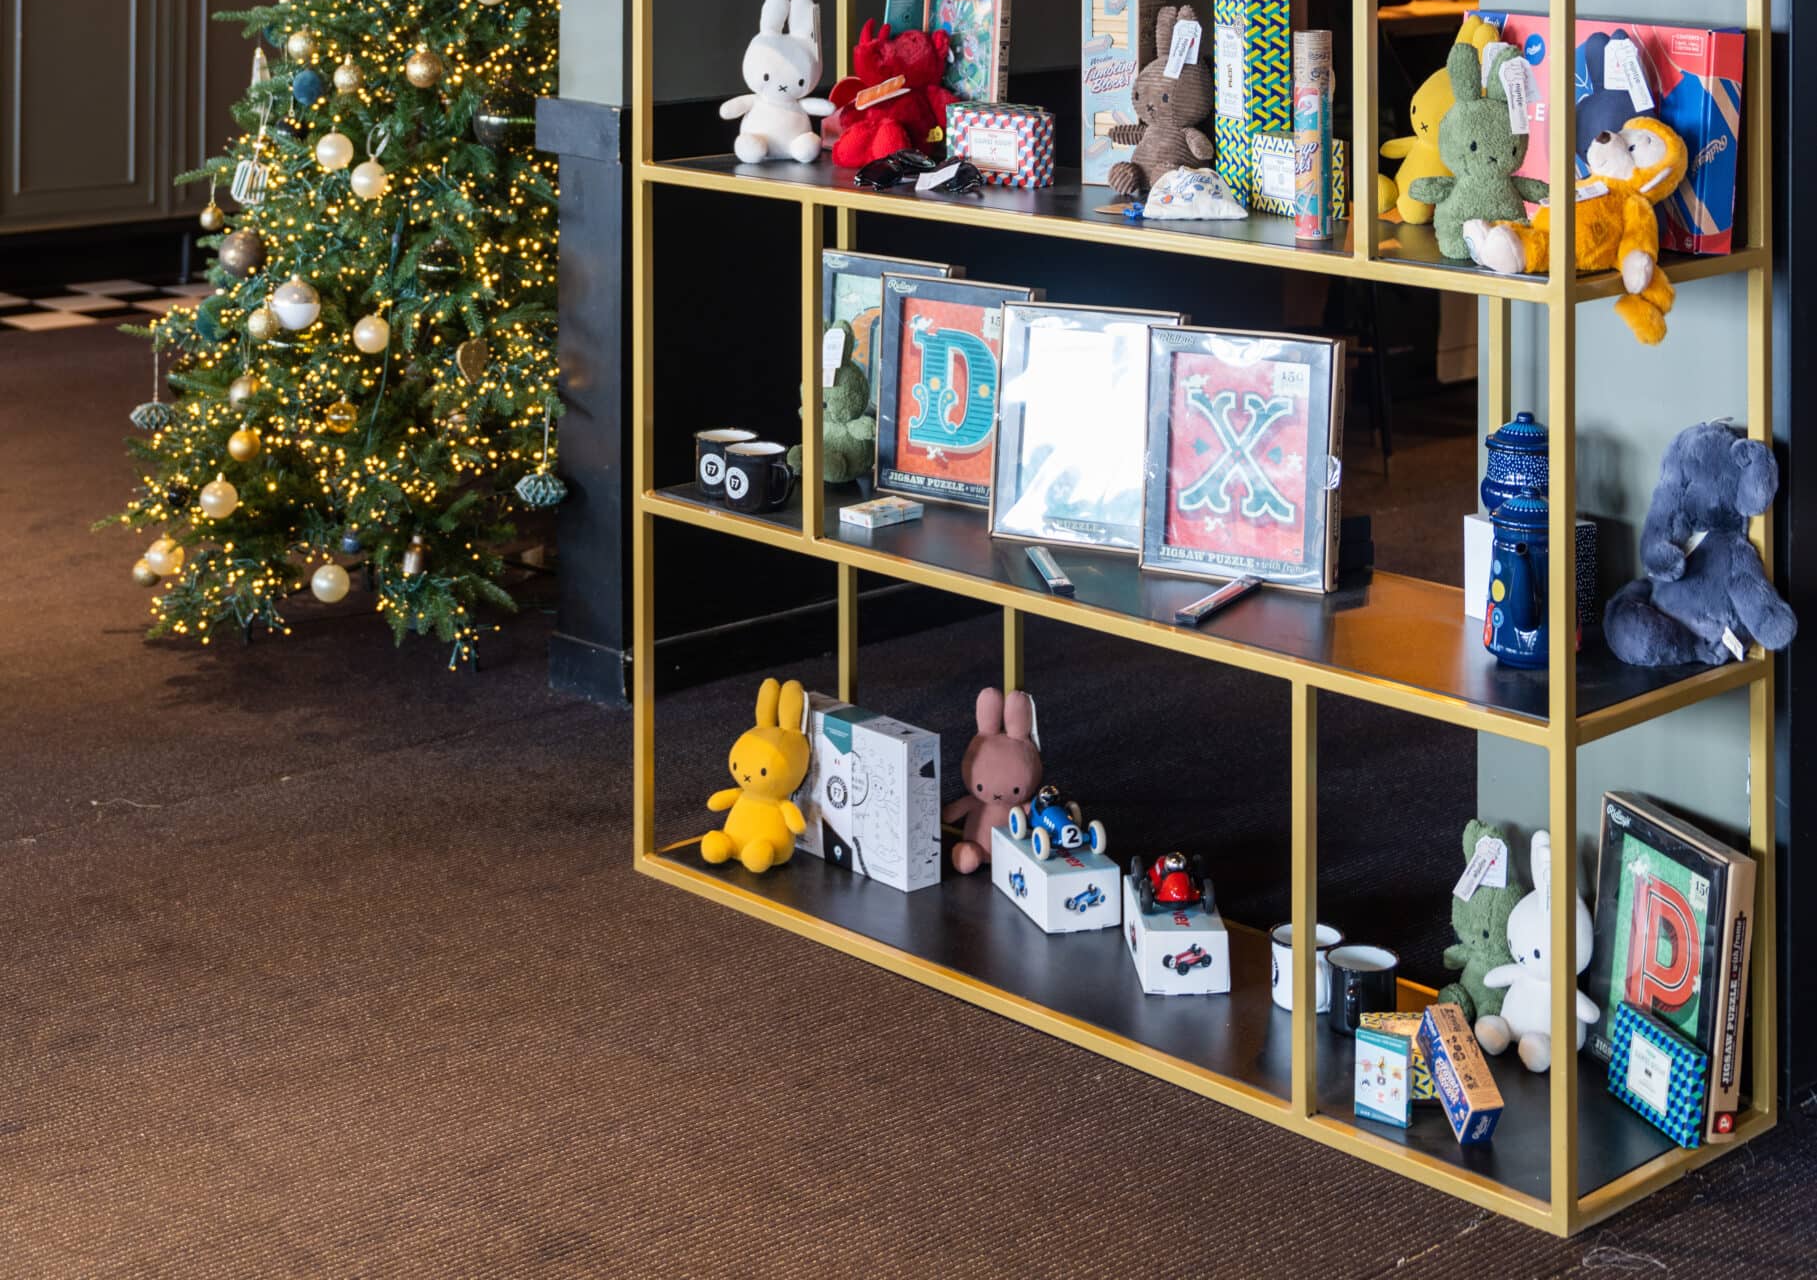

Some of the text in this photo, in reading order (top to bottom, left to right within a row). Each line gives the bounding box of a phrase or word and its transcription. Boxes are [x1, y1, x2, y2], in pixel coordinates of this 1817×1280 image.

[1178, 391, 1295, 524] X
[888, 472, 926, 485] JIGSAW
[927, 476, 965, 491] PUZZLE
[1159, 546, 1206, 561] JIGSAW
[1208, 552, 1255, 569] PUZZLE
[1066, 827, 1081, 844] 2
[1726, 979, 1738, 1031] PUZZLE
[1721, 1034, 1733, 1085] JIGSAW
